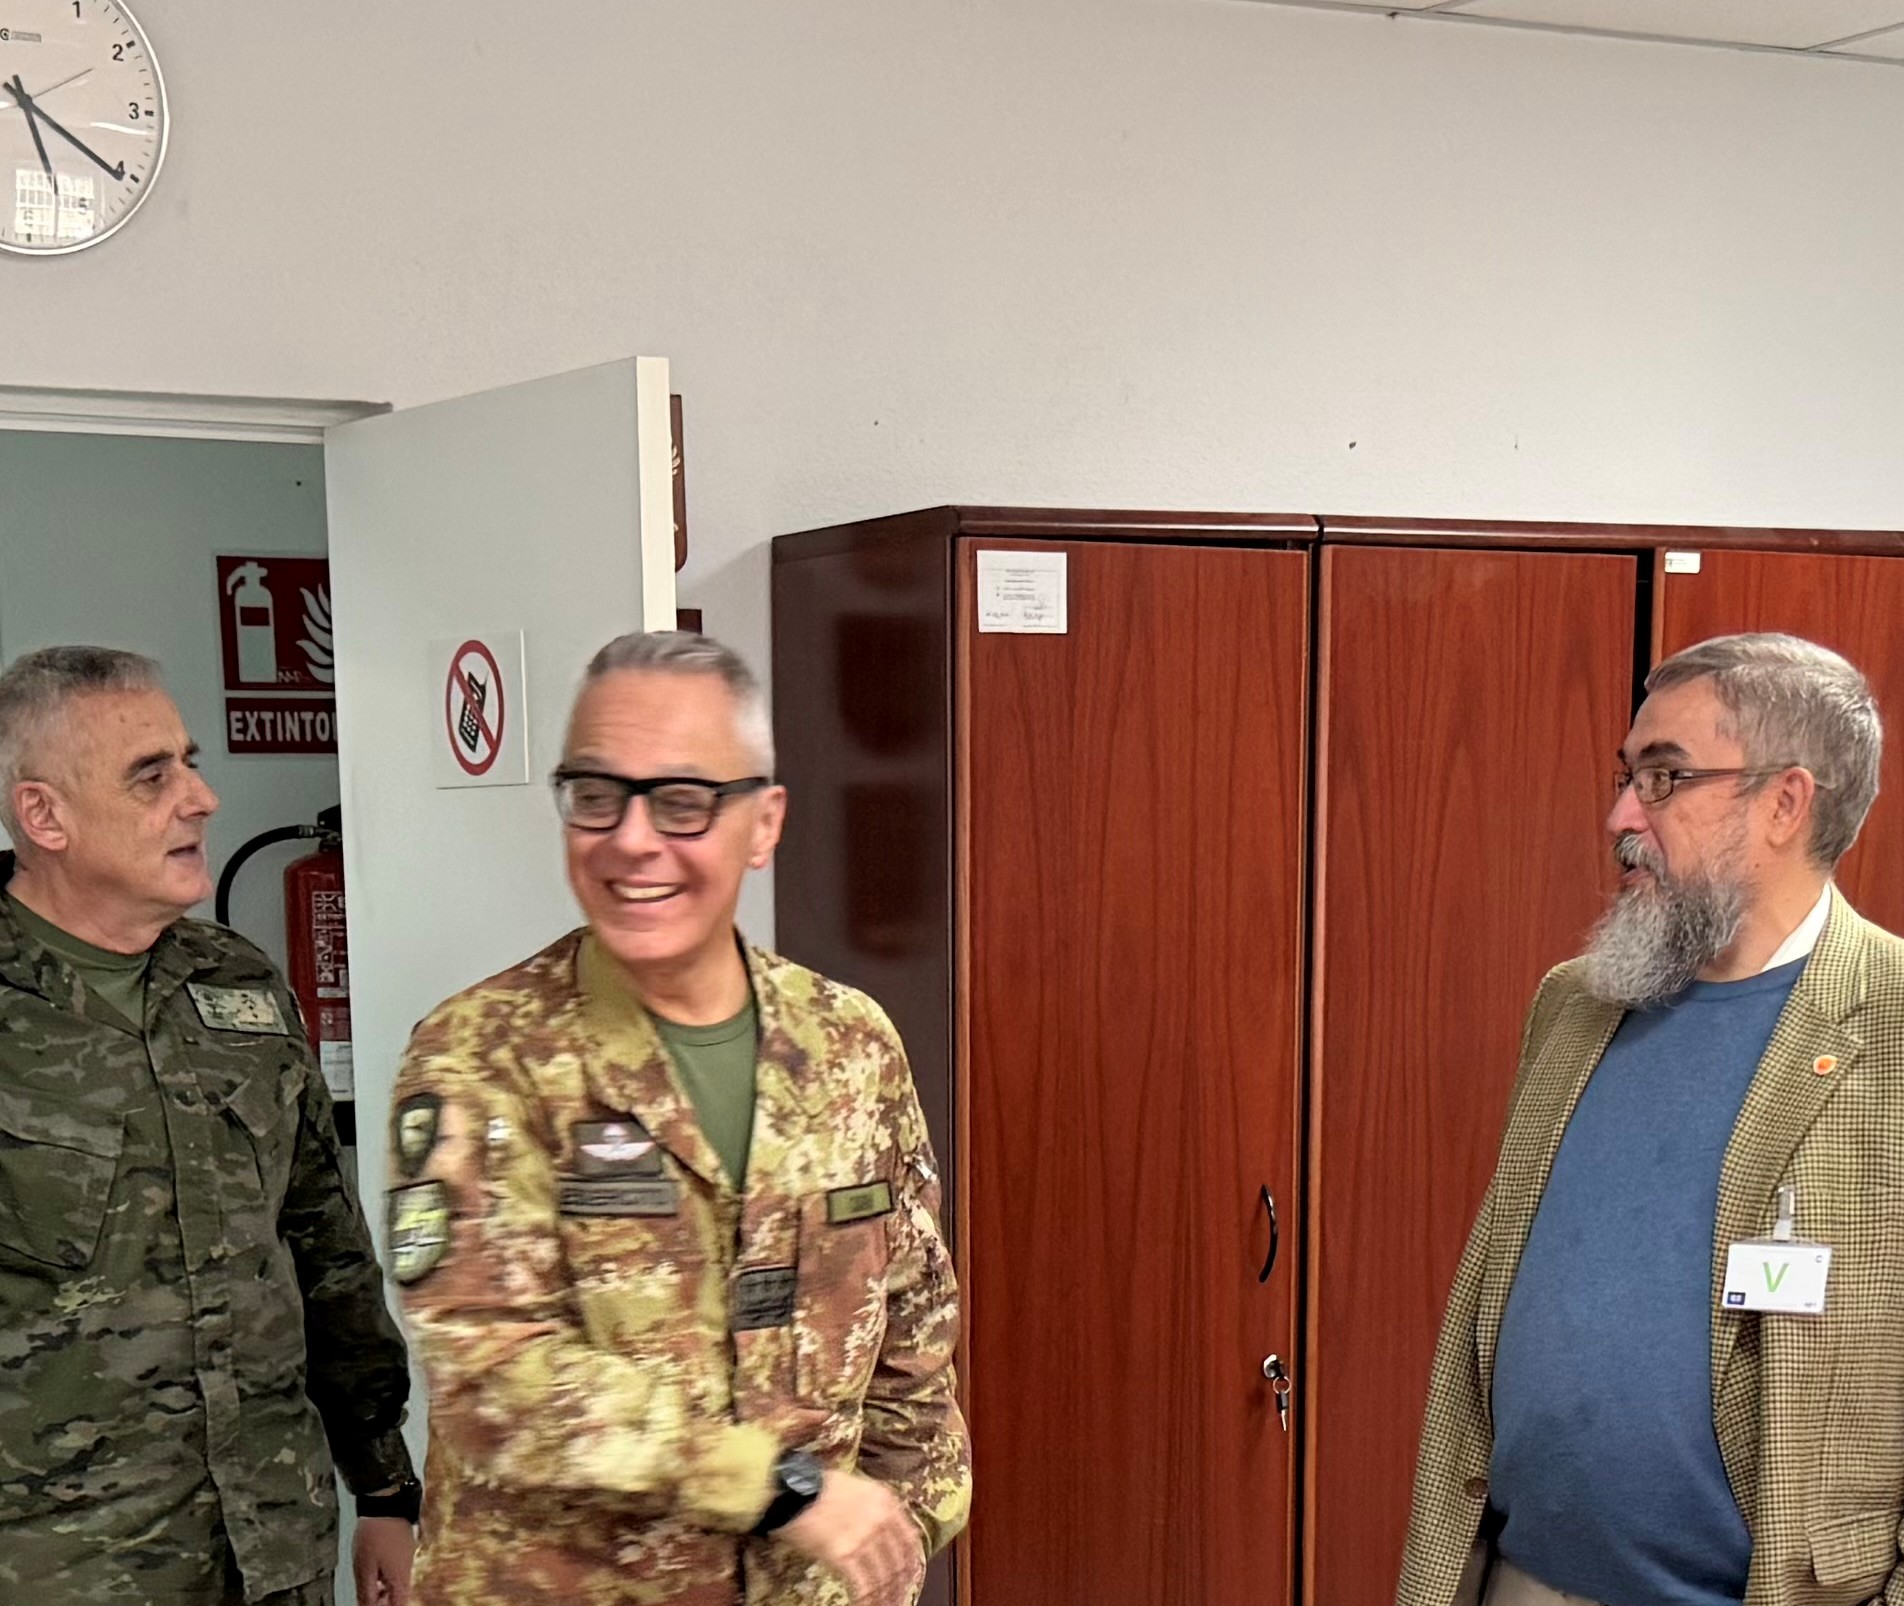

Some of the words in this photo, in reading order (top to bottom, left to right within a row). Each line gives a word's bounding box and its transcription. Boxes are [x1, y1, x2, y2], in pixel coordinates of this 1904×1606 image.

[72, 1, 82, 18] 1
[112, 44, 124, 62] 2
[128, 102, 140, 120] 3
[1762, 1261, 1790, 1293] V
